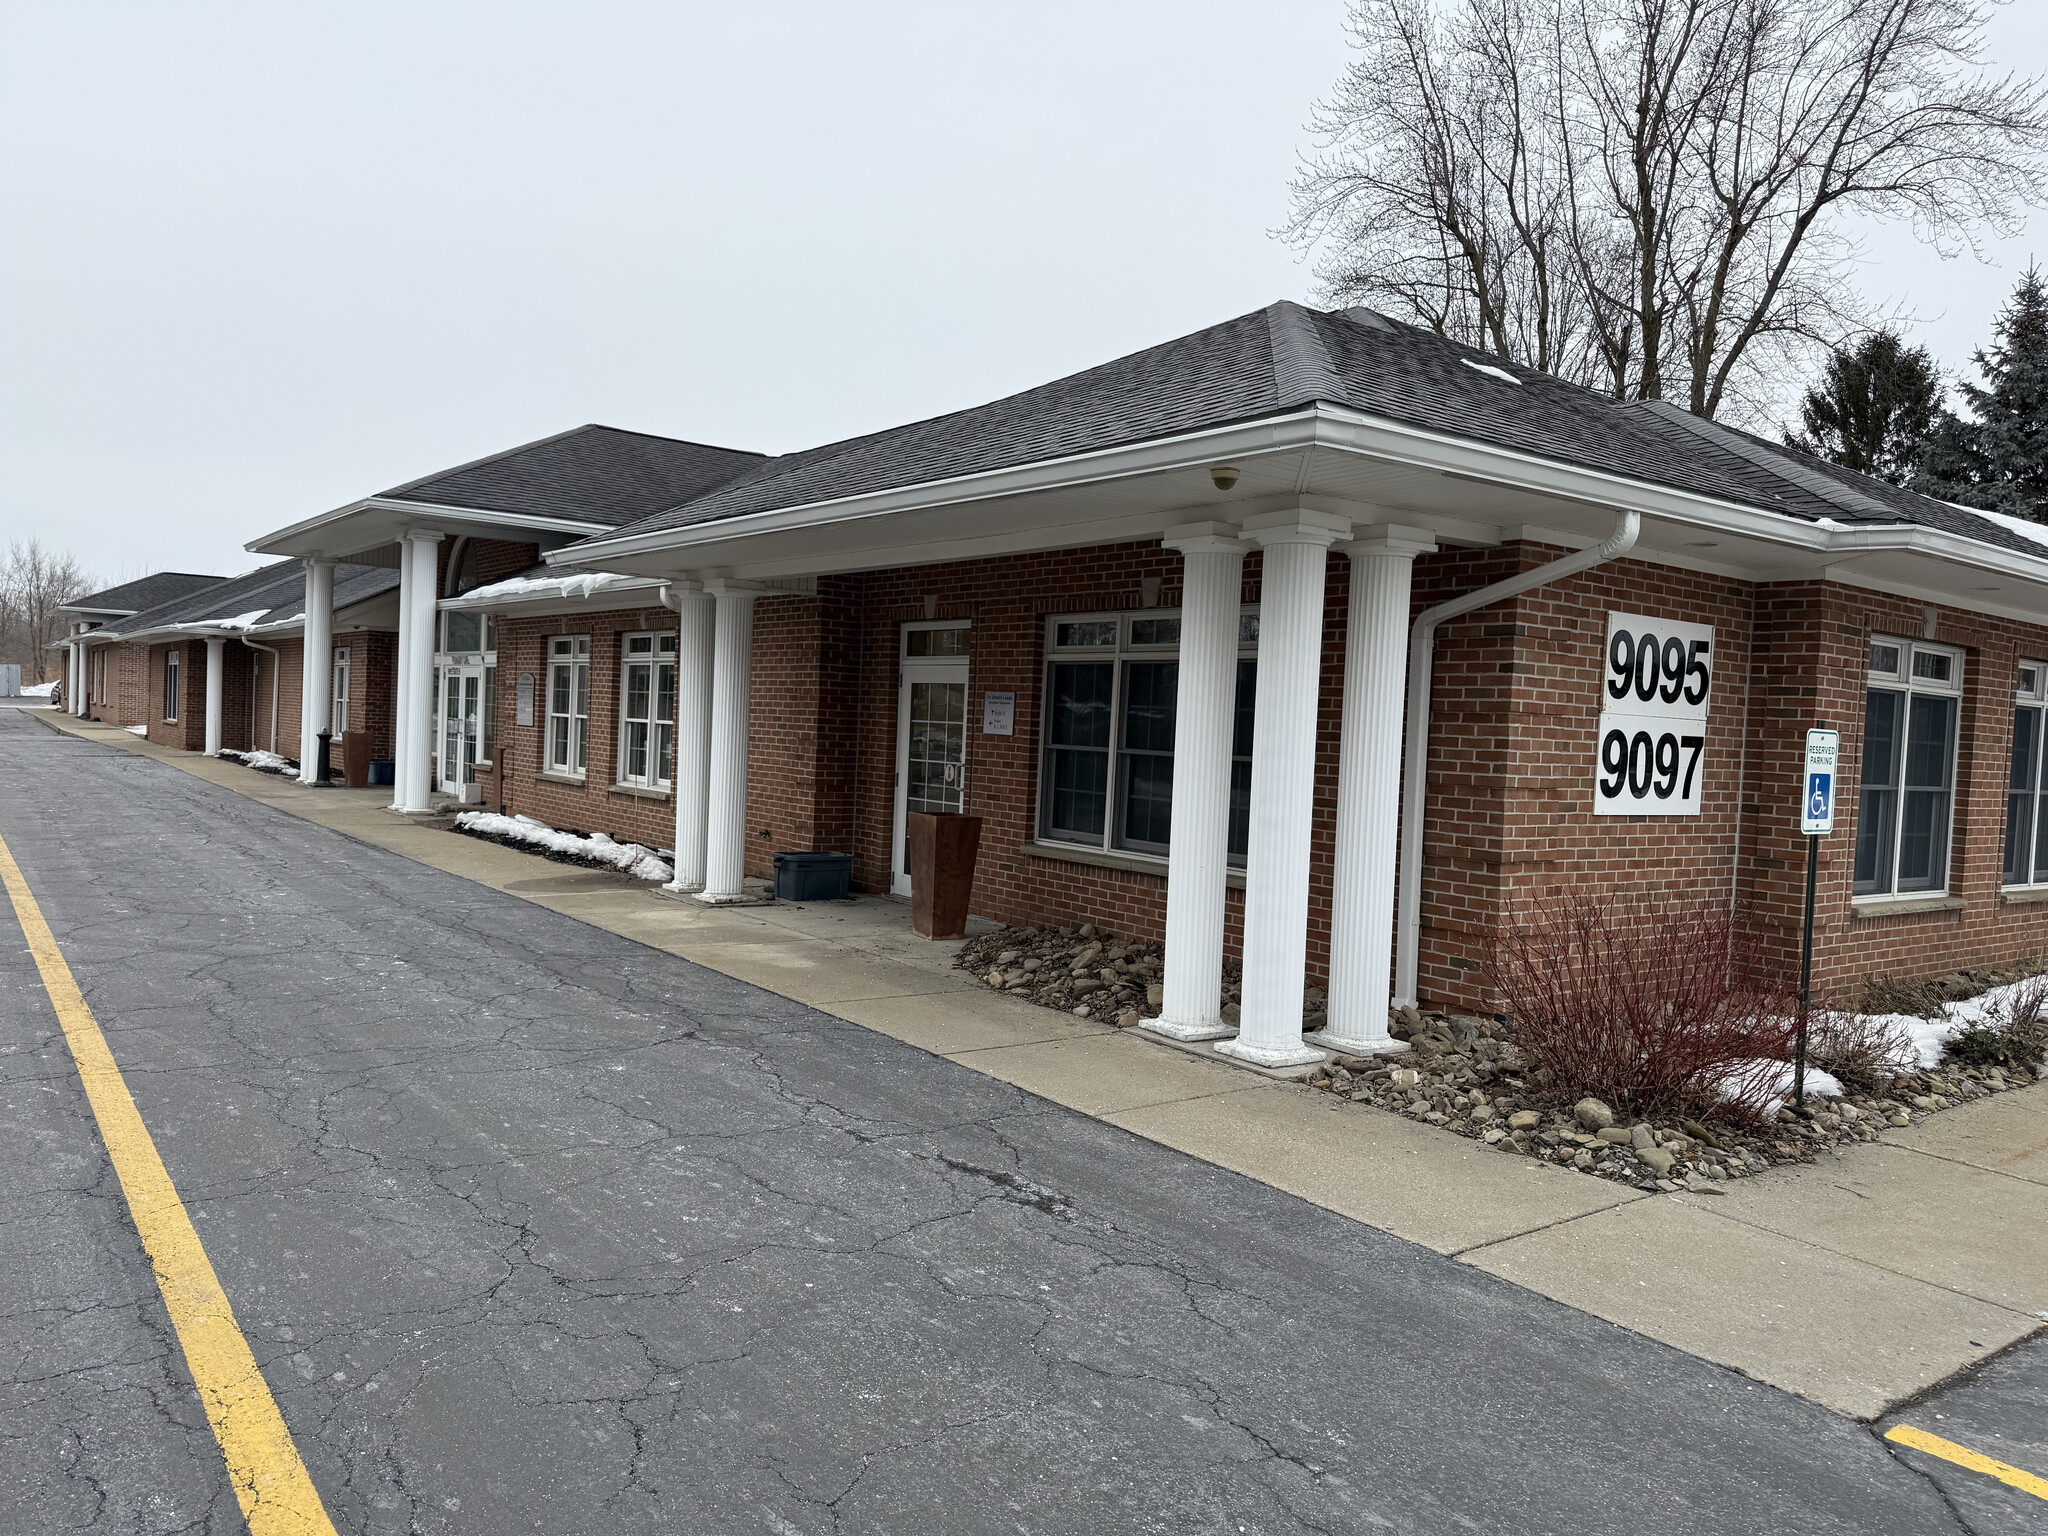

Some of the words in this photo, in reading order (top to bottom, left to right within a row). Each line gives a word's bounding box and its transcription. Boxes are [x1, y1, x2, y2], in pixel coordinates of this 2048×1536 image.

[1608, 629, 1710, 706] 9095
[1599, 728, 1705, 800] 9097
[1809, 745, 1835, 755] RESERVED
[1810, 756, 1833, 765] PARKING
